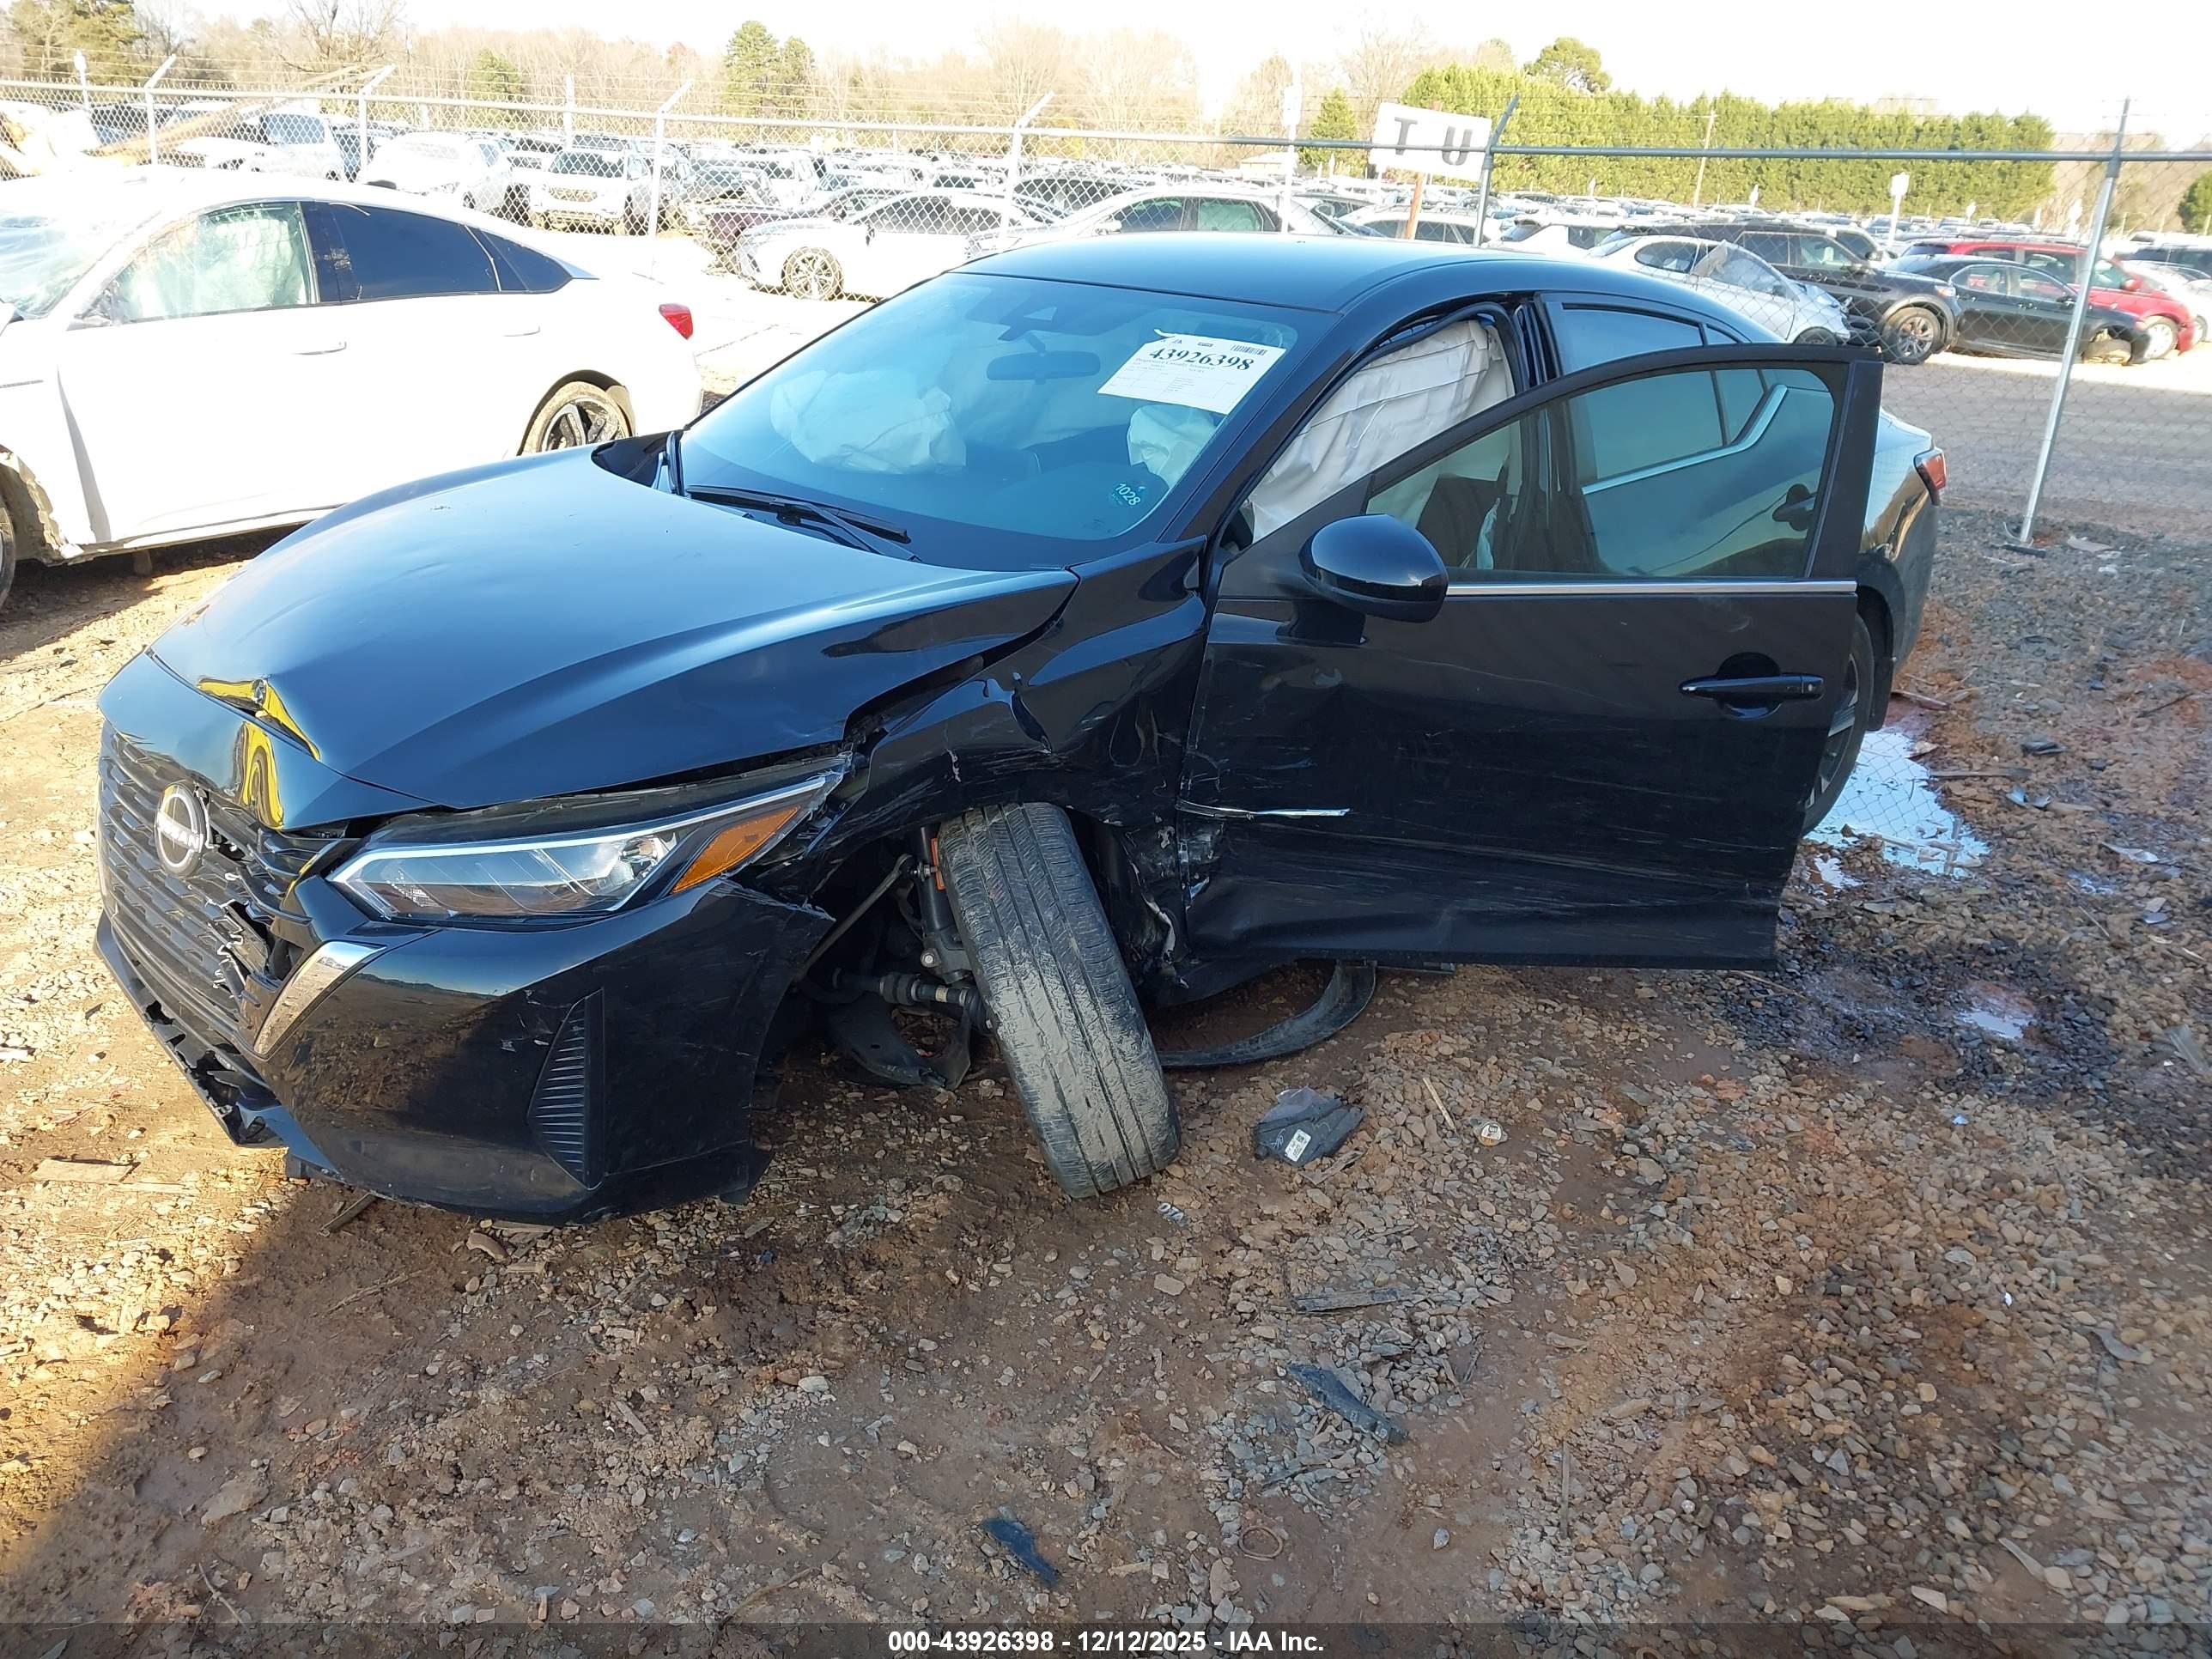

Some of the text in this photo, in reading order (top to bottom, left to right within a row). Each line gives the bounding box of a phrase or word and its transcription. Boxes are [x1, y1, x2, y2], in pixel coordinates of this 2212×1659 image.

[1395, 116, 1473, 166] T U
[1149, 347, 1255, 371] 43926398
[1115, 483, 1141, 506] 1028
